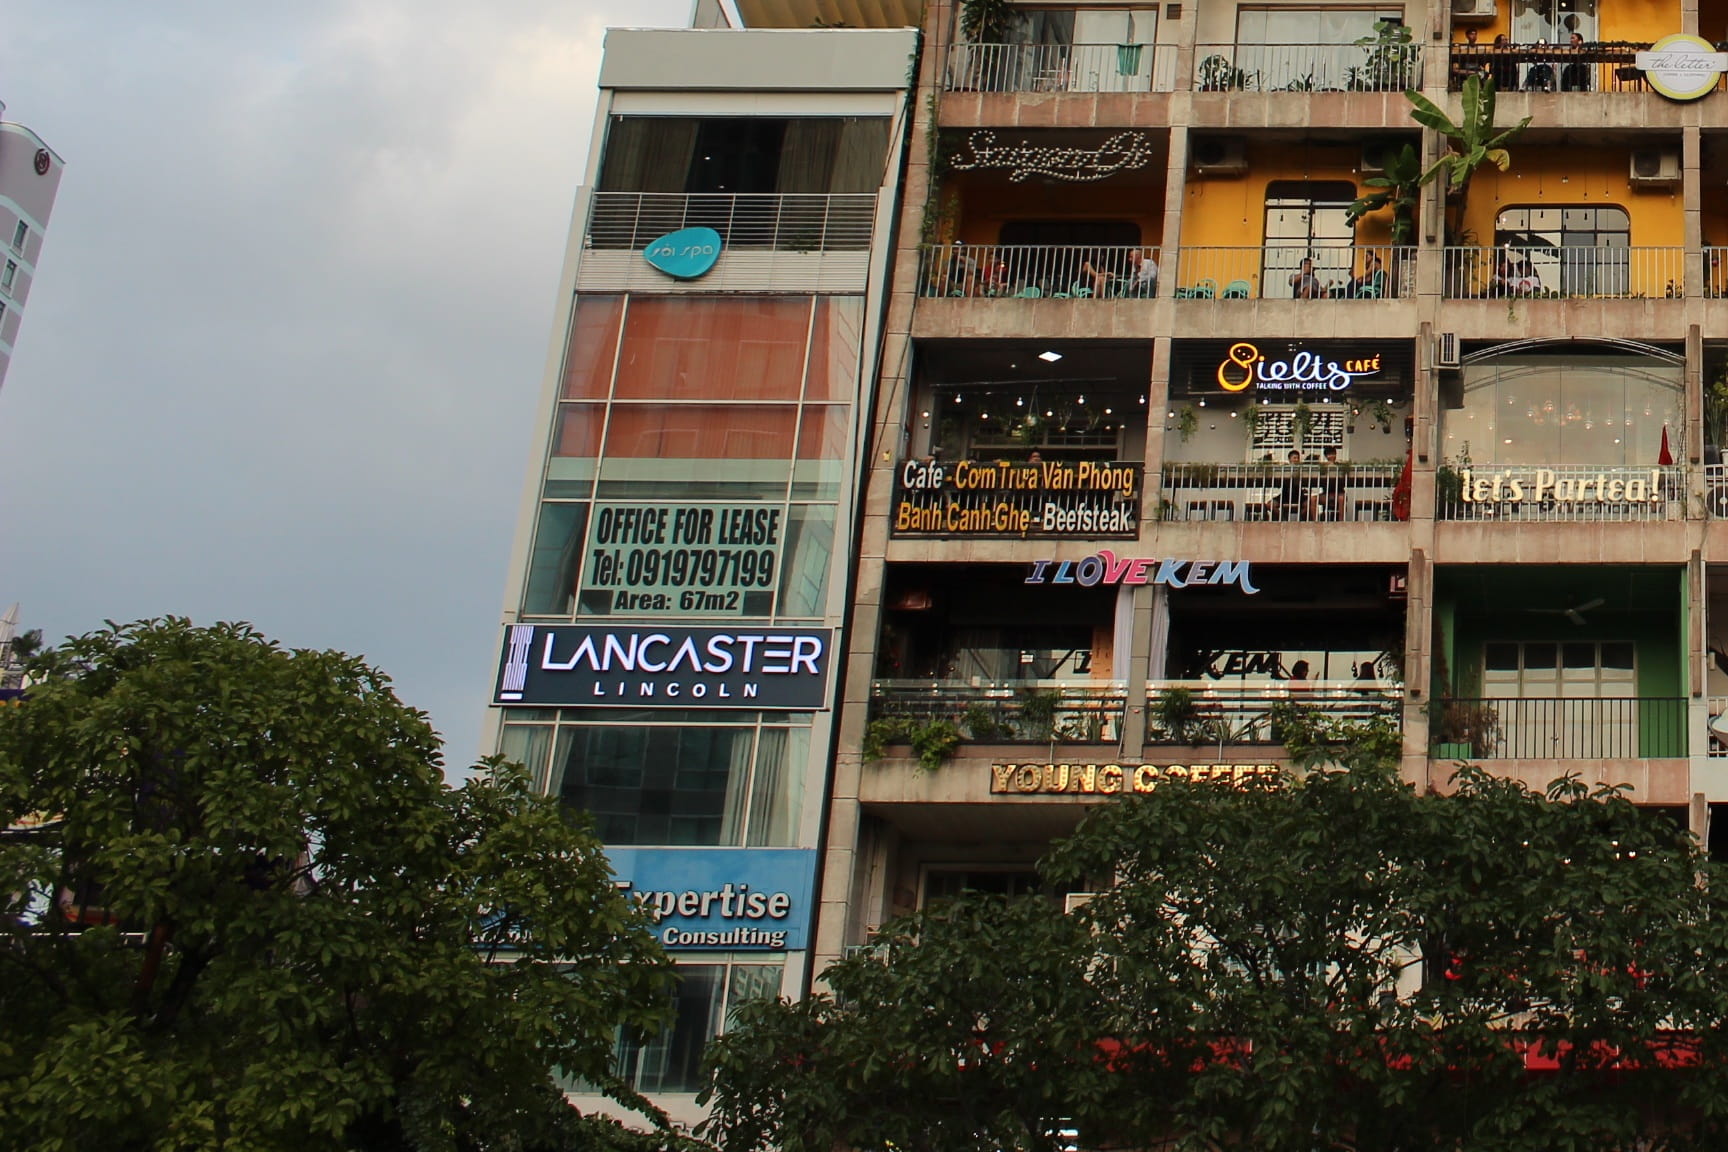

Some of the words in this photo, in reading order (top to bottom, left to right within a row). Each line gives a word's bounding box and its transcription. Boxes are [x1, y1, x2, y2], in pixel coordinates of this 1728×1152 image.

[1345, 353, 1380, 372] CAFÉ
[1256, 382, 1282, 390] TALKING
[1302, 382, 1327, 390] COFFEE
[1043, 461, 1073, 489] Văn
[1078, 461, 1134, 497] Phòng
[596, 507, 668, 544] OFFICE
[671, 508, 714, 545] FOR
[718, 509, 780, 546] LEASE
[1043, 502, 1132, 532] Beefsteak
[591, 549, 625, 586] Tel:
[626, 549, 775, 587] 0919797199
[1024, 560, 1052, 584] I
[1052, 550, 1155, 587] LOVE
[1155, 558, 1261, 595] KEM
[614, 591, 671, 611] Area:
[679, 591, 740, 611] 67m2
[540, 631, 822, 675] LANCASTER
[593, 681, 758, 698] LINCOLN
[992, 764, 1123, 794] YOUNG
[662, 927, 787, 948] Consulting
